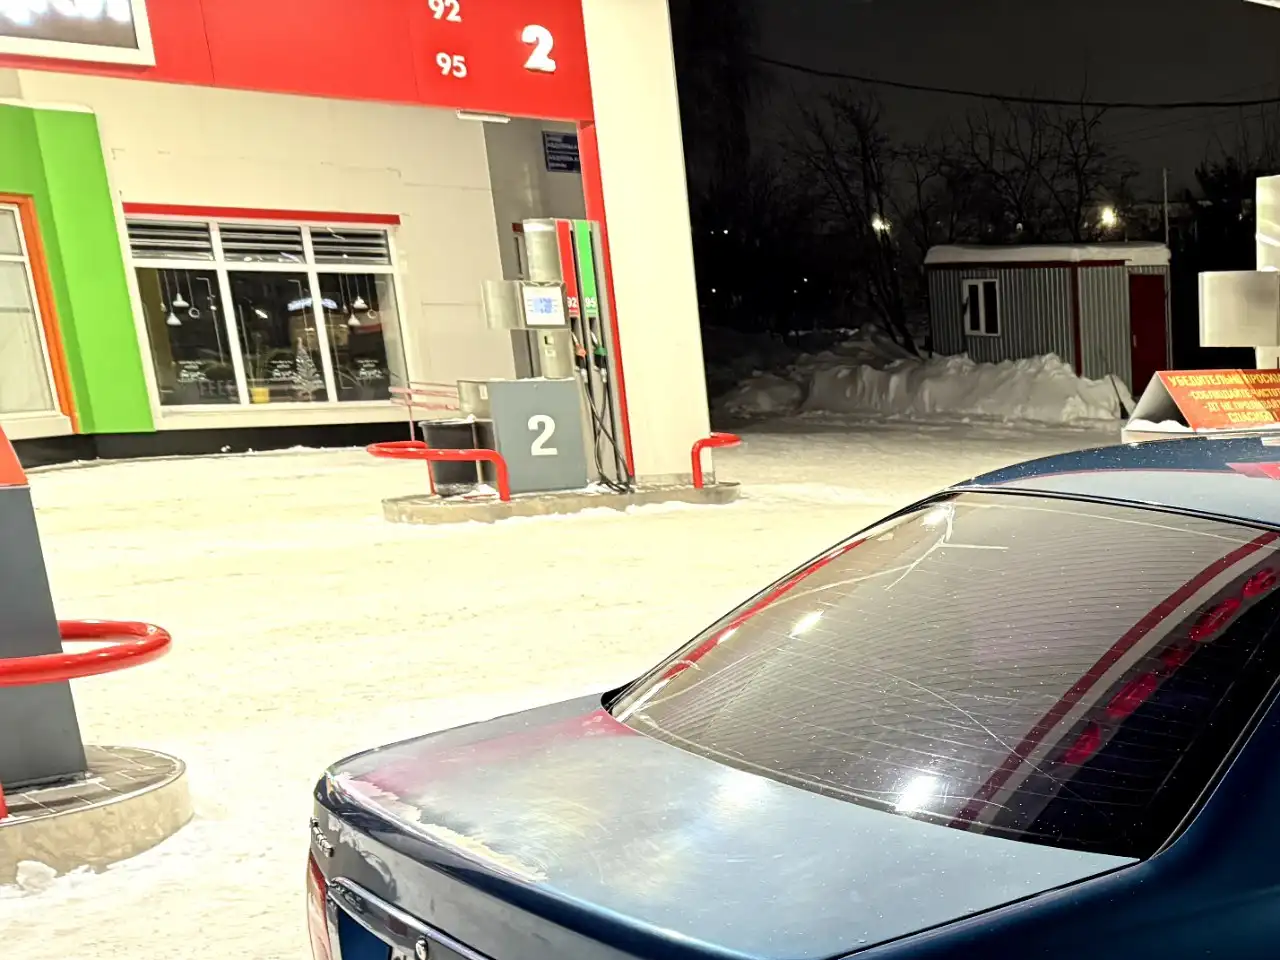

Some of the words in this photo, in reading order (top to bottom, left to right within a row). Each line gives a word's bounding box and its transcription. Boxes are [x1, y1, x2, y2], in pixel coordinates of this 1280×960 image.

[428, 0, 462, 22] 92
[521, 24, 556, 72] 2
[436, 52, 468, 78] 95
[567, 296, 578, 308] 92
[528, 414, 558, 456] 2
